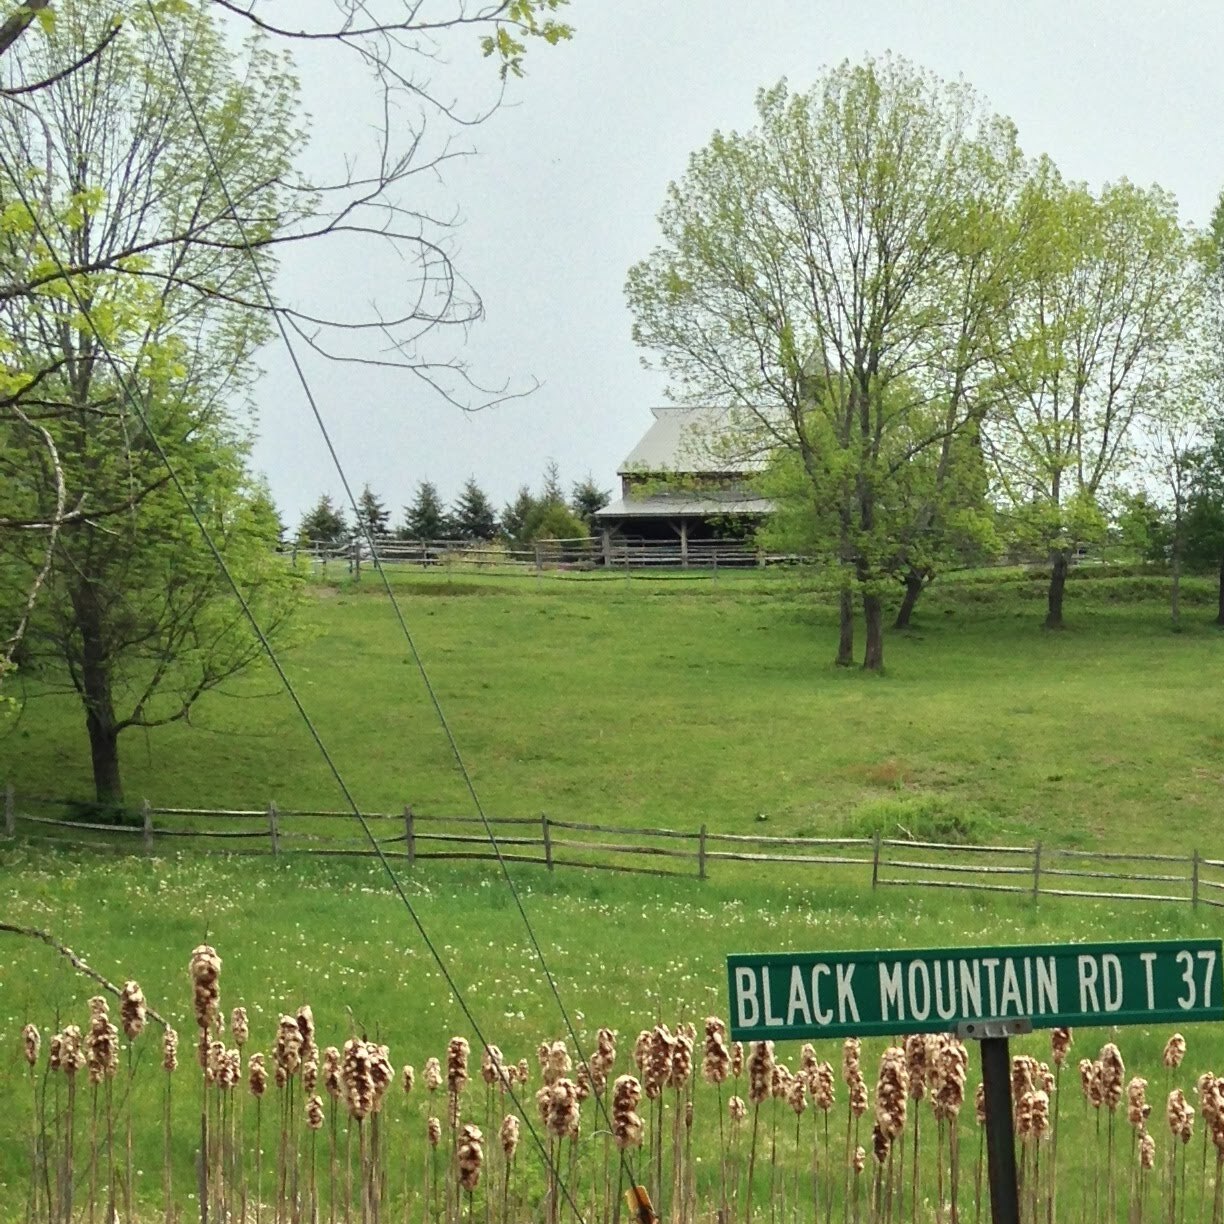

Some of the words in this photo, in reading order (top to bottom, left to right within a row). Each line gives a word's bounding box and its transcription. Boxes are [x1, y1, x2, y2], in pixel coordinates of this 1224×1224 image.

[735, 963, 861, 1028] BLACK
[878, 956, 1060, 1021] MOUNTAIN
[1078, 954, 1123, 1014] RD
[1140, 952, 1158, 1010] T
[1175, 950, 1216, 1010] 37
